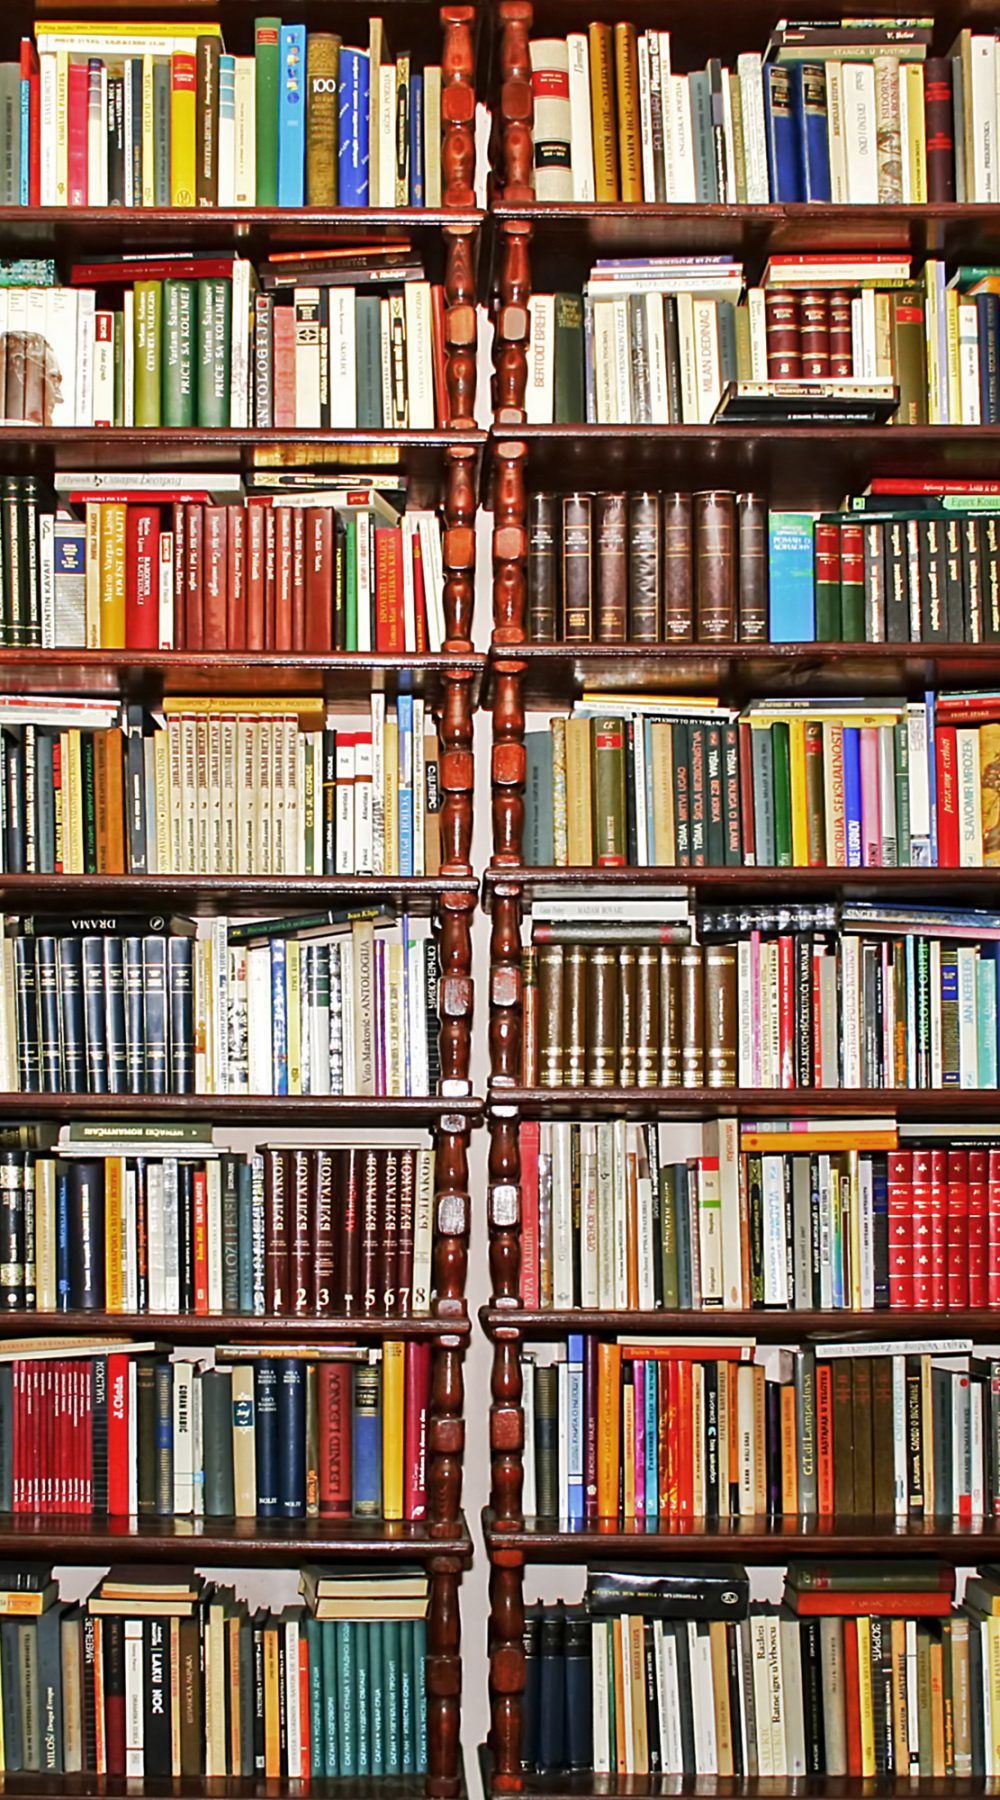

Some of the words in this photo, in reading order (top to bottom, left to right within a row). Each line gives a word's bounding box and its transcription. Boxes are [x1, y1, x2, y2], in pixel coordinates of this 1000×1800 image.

[312, 79, 336, 93] 100
[167, 286, 178, 327] Šalamov
[202, 286, 213, 326] Šalamov
[534, 302, 546, 341] BREHT
[168, 331, 178, 366] Varlam
[180, 342, 191, 356] SA
[202, 330, 212, 365] Varlam
[700, 309, 711, 357] DEDINAC
[215, 344, 224, 359] SA
[180, 361, 191, 394] PRIČE
[215, 364, 224, 398] PRIČE
[702, 359, 712, 393] MILAN
[708, 749, 719, 778] TIŠMA
[727, 748, 737, 777] TIŠMA
[831, 726, 845, 813] SEKSUALNOSTI
[677, 767, 687, 792] UGAO
[729, 811, 738, 819] O
[964, 786, 975, 841] SLAVOMIR
[677, 823, 688, 852] TIŠMA
[692, 823, 703, 850] TIŠMA
[729, 821, 738, 852] BLAMU
[71, 919, 116, 930] DRAMA
[360, 940, 371, 1011] ANTOLOGIJA
[800, 943, 810, 981] VARVARE
[361, 1019, 372, 1063] Marković
[362, 1064, 372, 1084] Vito
[273, 1156, 284, 1231] БУЛГАКОВ
[297, 1156, 308, 1231] БУЛГАКОВ
[320, 1156, 333, 1232] БУЛГАКОВ
[365, 1156, 377, 1231] БУЛГАКОВ
[385, 1156, 397, 1231] БУЛГАКОВ
[400, 1155, 413, 1230] БУЛГАКОВ
[417, 1156, 431, 1230] БУЛГАКОВ
[274, 1288, 283, 1306] 1
[296, 1288, 307, 1306] 2
[319, 1288, 330, 1306] 3
[365, 1288, 376, 1306] 5
[384, 1288, 395, 1306] 6
[399, 1288, 410, 1306] 7
[415, 1287, 426, 1304] 8
[96, 1361, 105, 1404] КОСТИЋ
[178, 1385, 188, 1409] GORAN
[802, 1374, 813, 1441] Lampedusa
[871, 1623, 882, 1662] ЗОРИЋ
[151, 1653, 162, 1683] LAKU
[151, 1689, 165, 1714] NOĆ
[772, 1694, 781, 1725] Ratne
